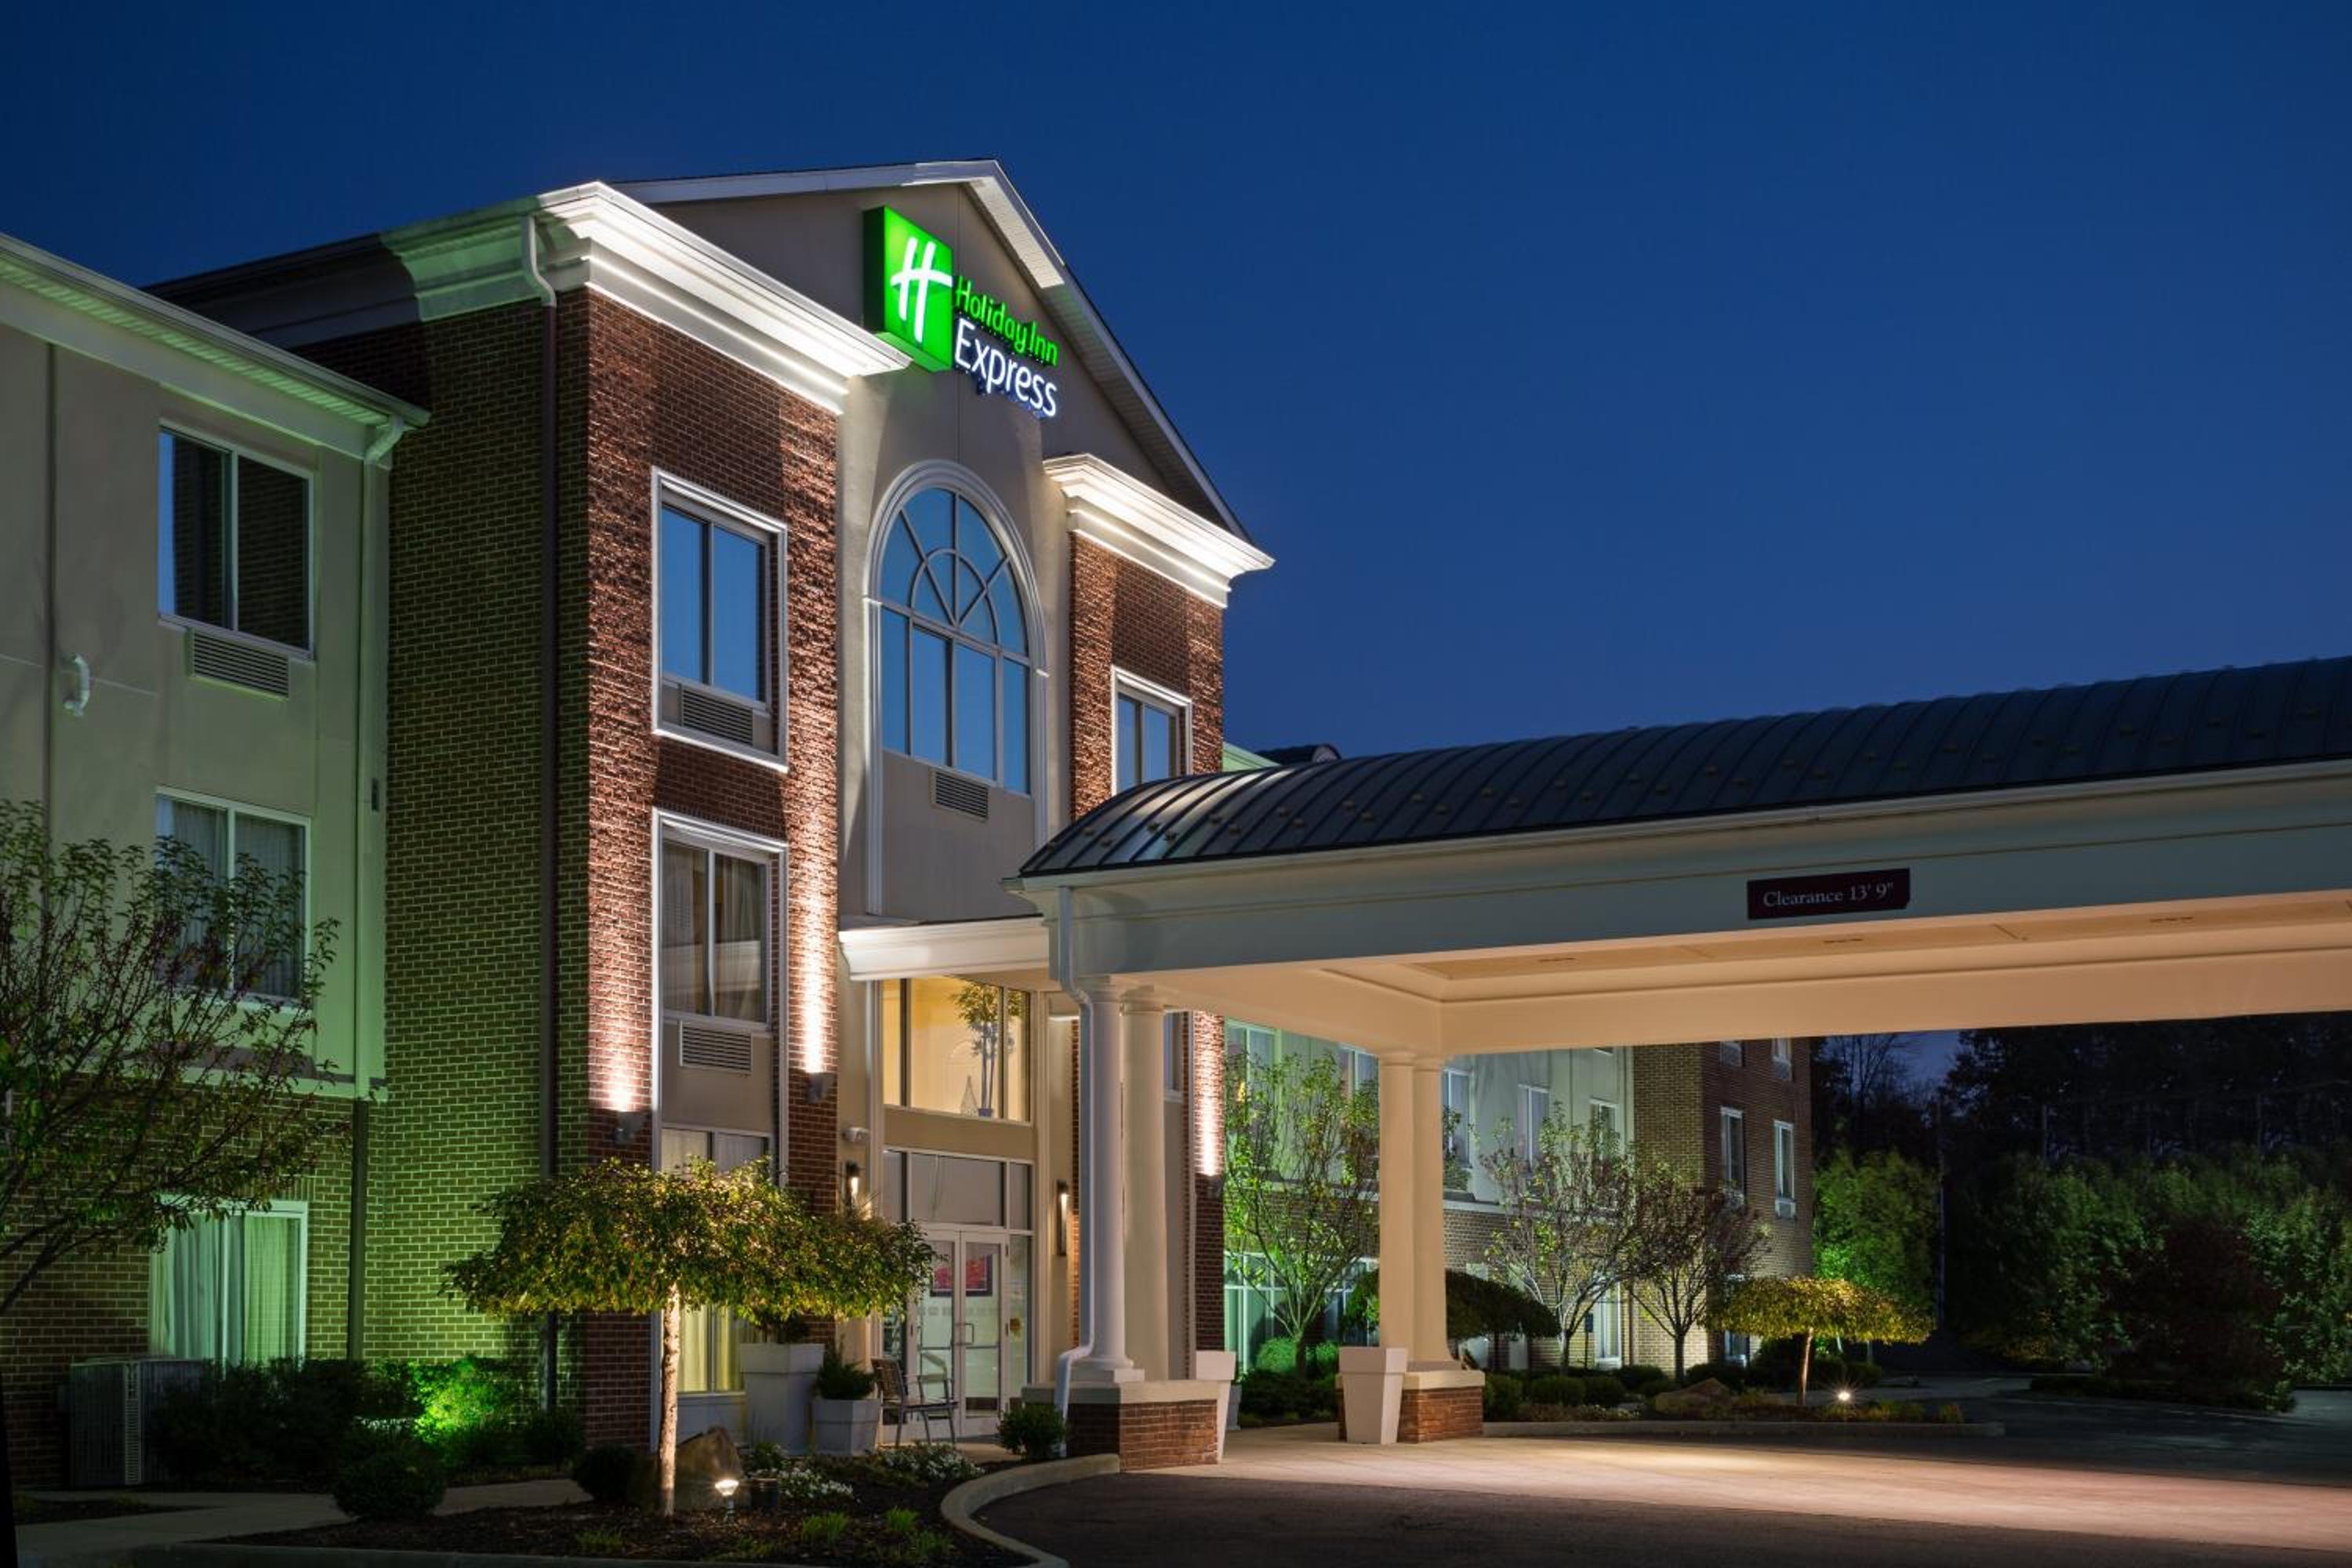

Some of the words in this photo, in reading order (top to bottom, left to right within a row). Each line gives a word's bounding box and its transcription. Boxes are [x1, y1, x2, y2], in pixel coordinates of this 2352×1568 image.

[955, 275, 1027, 354] Holiday
[1028, 321, 1058, 366] Inn
[954, 318, 1058, 417] Express
[1763, 891, 1843, 907] Clearance
